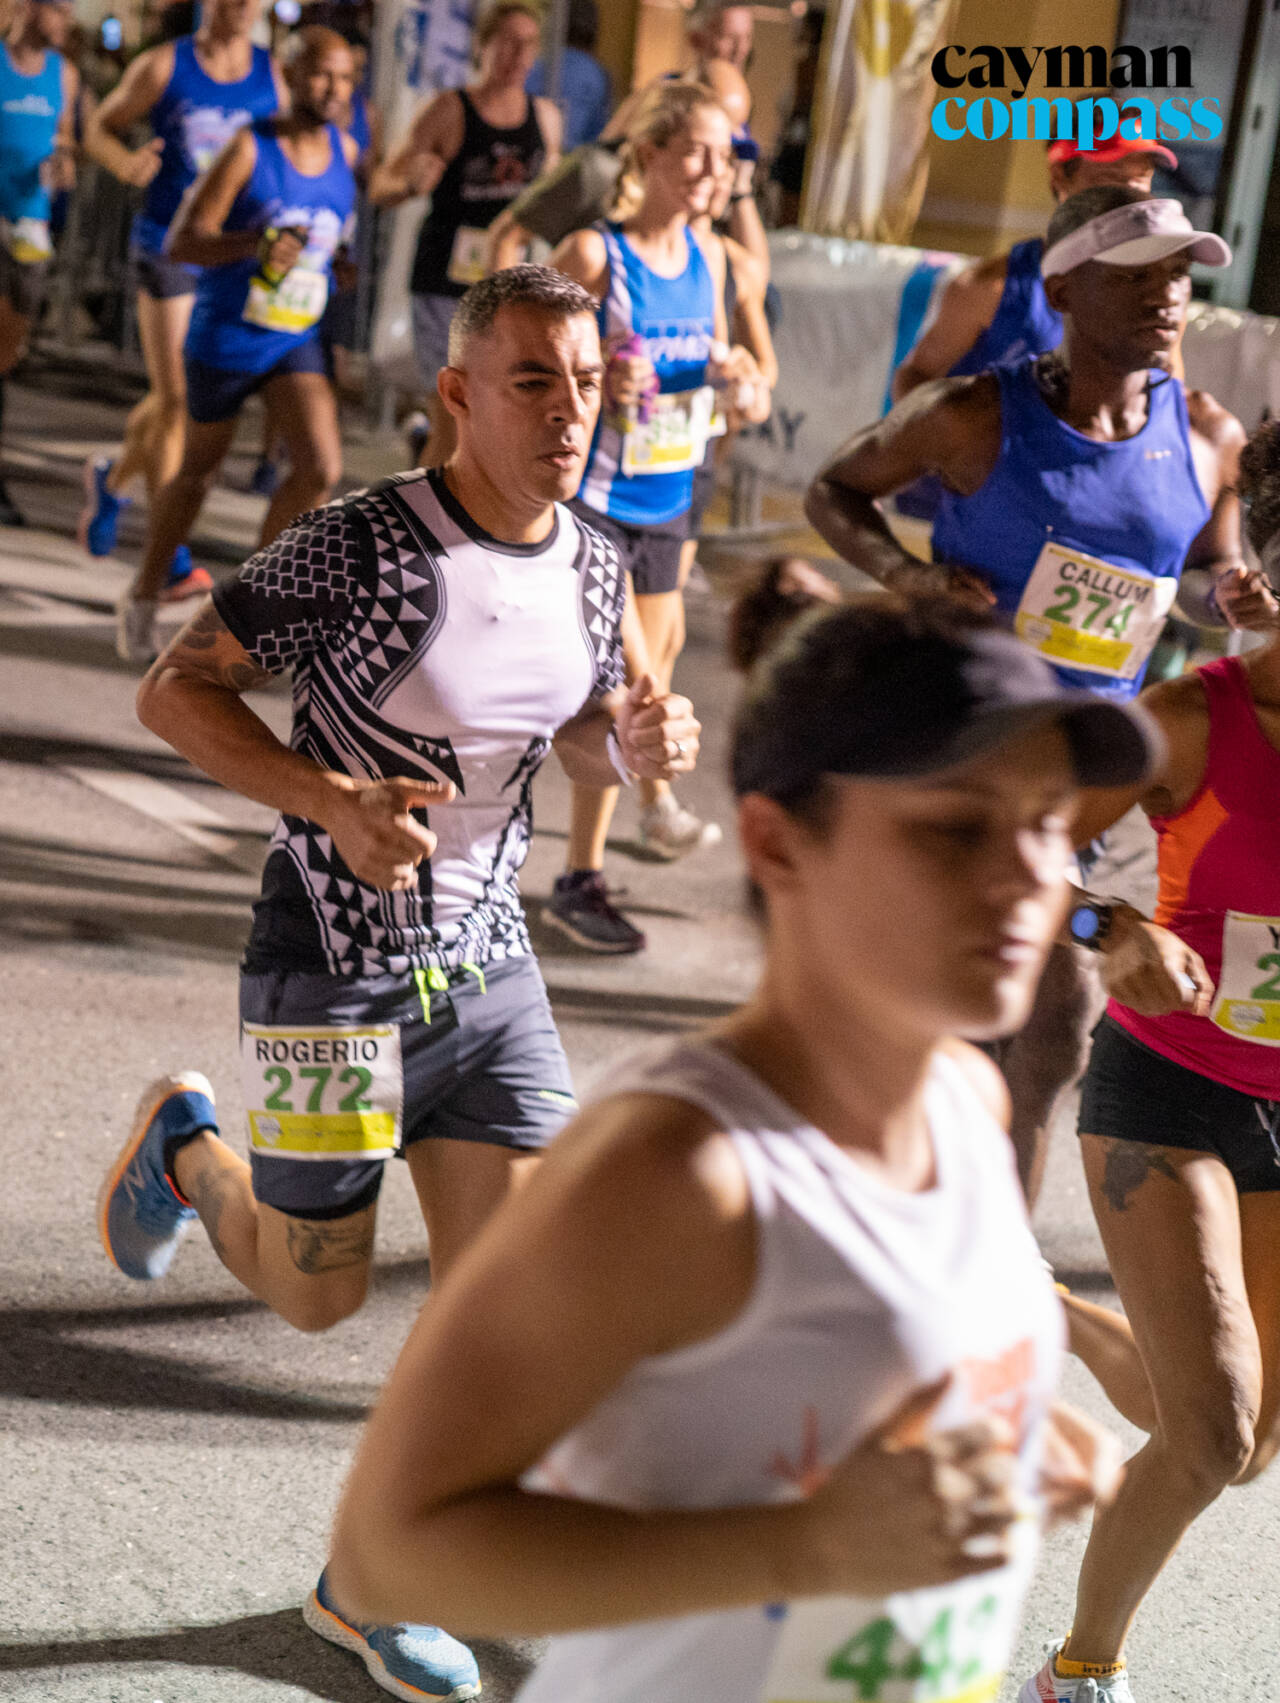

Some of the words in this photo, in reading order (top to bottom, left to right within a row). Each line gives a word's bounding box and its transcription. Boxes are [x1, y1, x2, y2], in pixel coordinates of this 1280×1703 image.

[1059, 561, 1151, 604] CALLUM
[1044, 584, 1136, 639] 274
[256, 1039, 379, 1064] ROGERIO
[263, 1065, 373, 1114] 272
